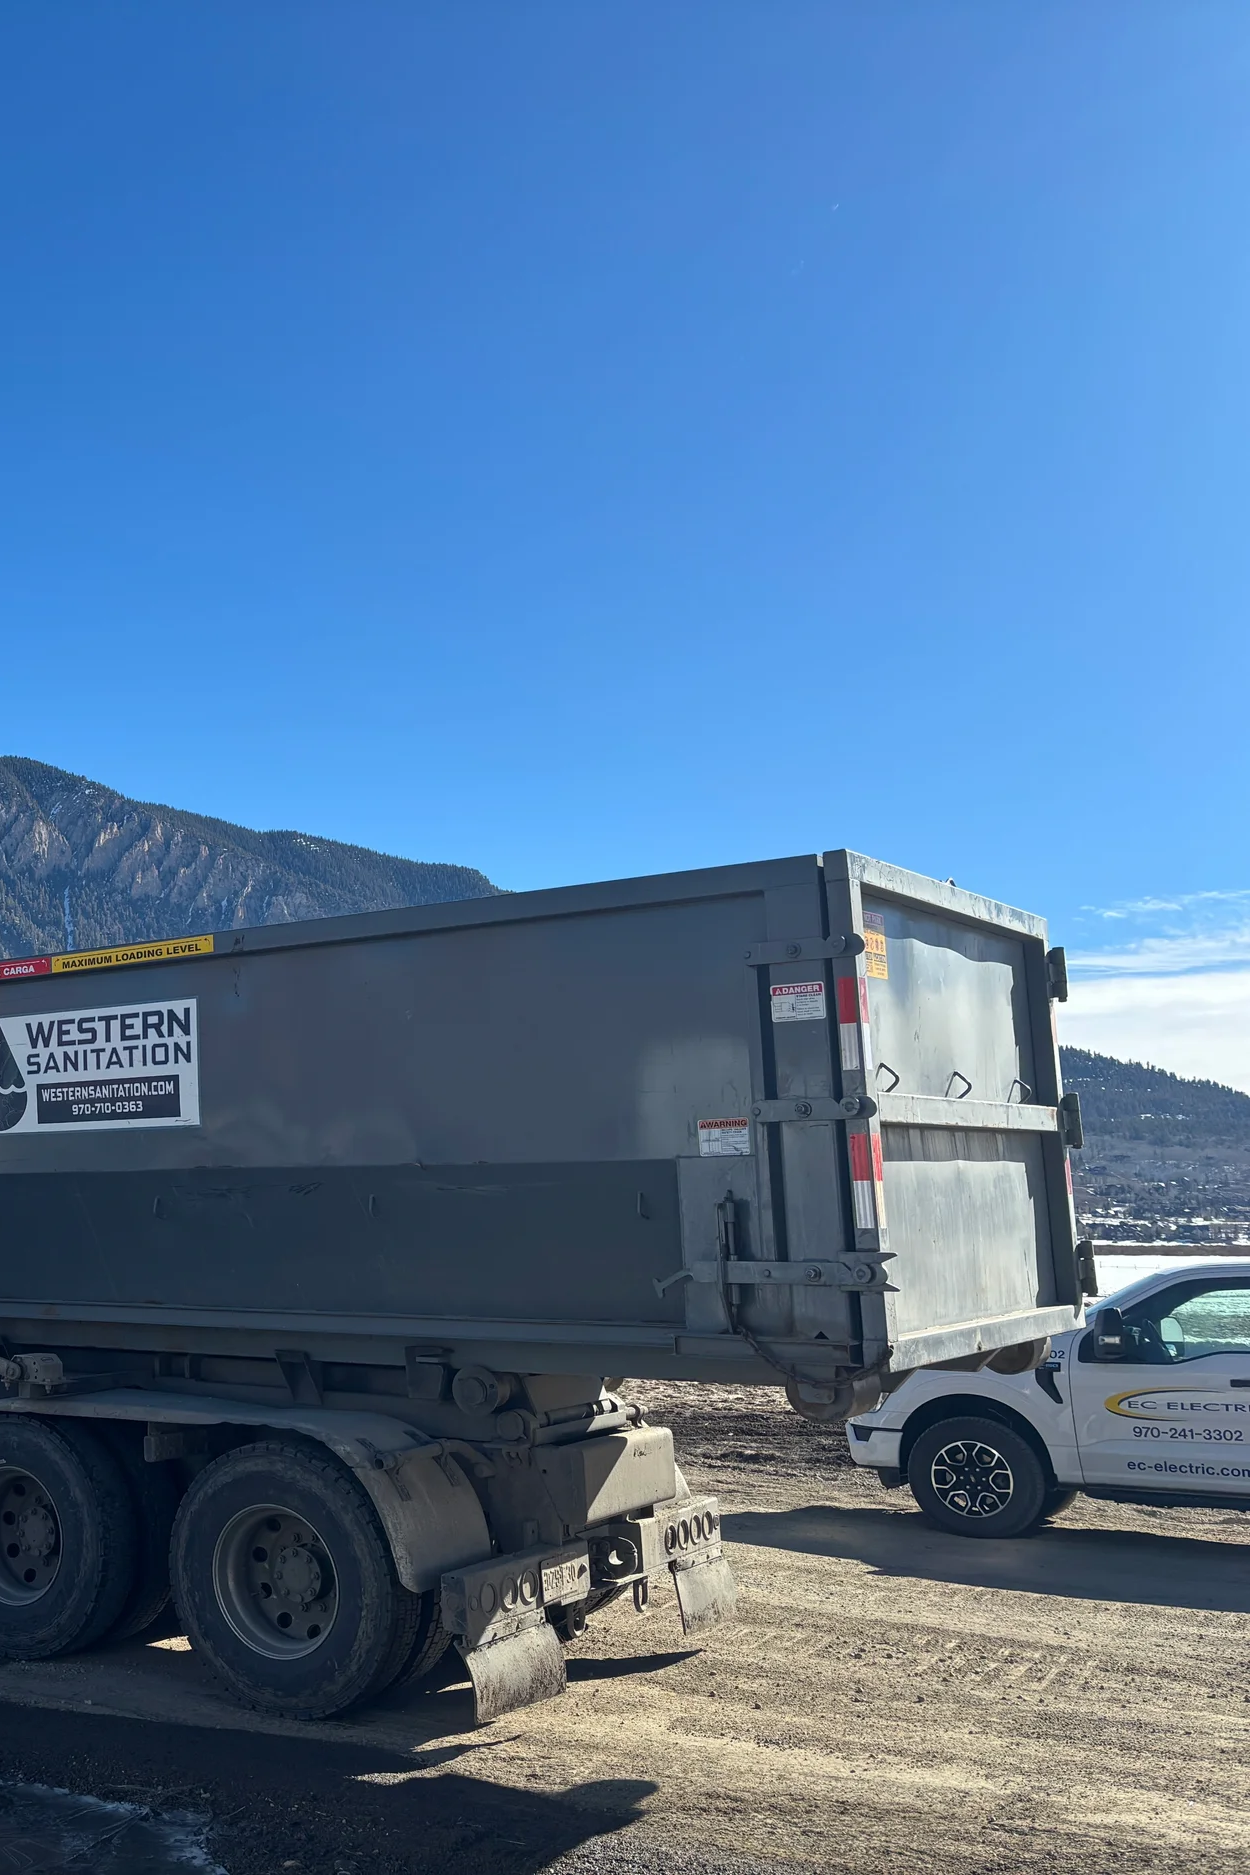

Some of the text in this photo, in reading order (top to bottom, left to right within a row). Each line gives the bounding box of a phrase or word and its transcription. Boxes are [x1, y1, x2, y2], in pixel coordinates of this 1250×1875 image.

[62, 943, 201, 969] MAXIMUM LOADING LEVEL
[3, 965, 35, 976] CARGA
[782, 984, 820, 994] DANGER
[25, 1007, 191, 1049] WESTERN
[26, 1040, 192, 1075] SANITATION
[41, 1080, 174, 1102] WESTERNSANITATION.COM
[71, 1101, 143, 1115] 970-710-0363
[705, 1119, 747, 1129] WARNING
[1127, 1400, 1157, 1410] EC
[1132, 1426, 1244, 1442] 970-241-3302
